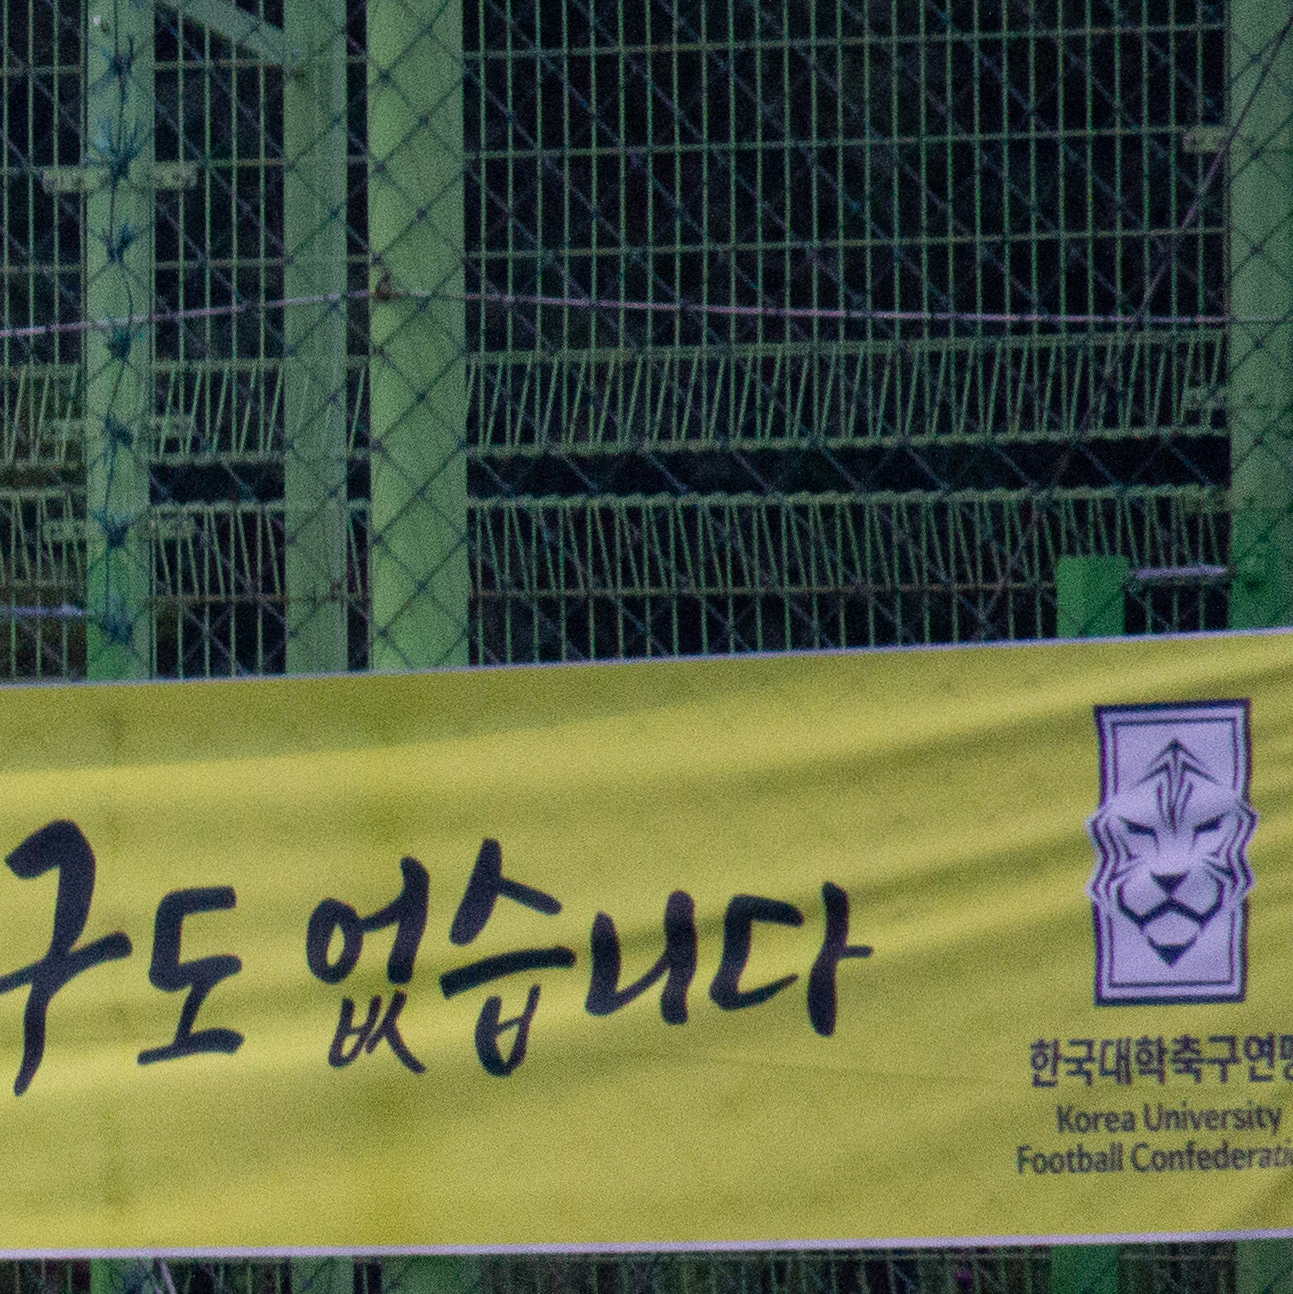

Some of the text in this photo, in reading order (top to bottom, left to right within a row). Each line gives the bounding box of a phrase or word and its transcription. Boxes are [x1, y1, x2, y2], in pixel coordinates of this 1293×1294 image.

[305, 830, 874, 1077] 없습니다
[1056, 1101, 1283, 1136] Korea University
[1017, 1142, 1124, 1175] Football
